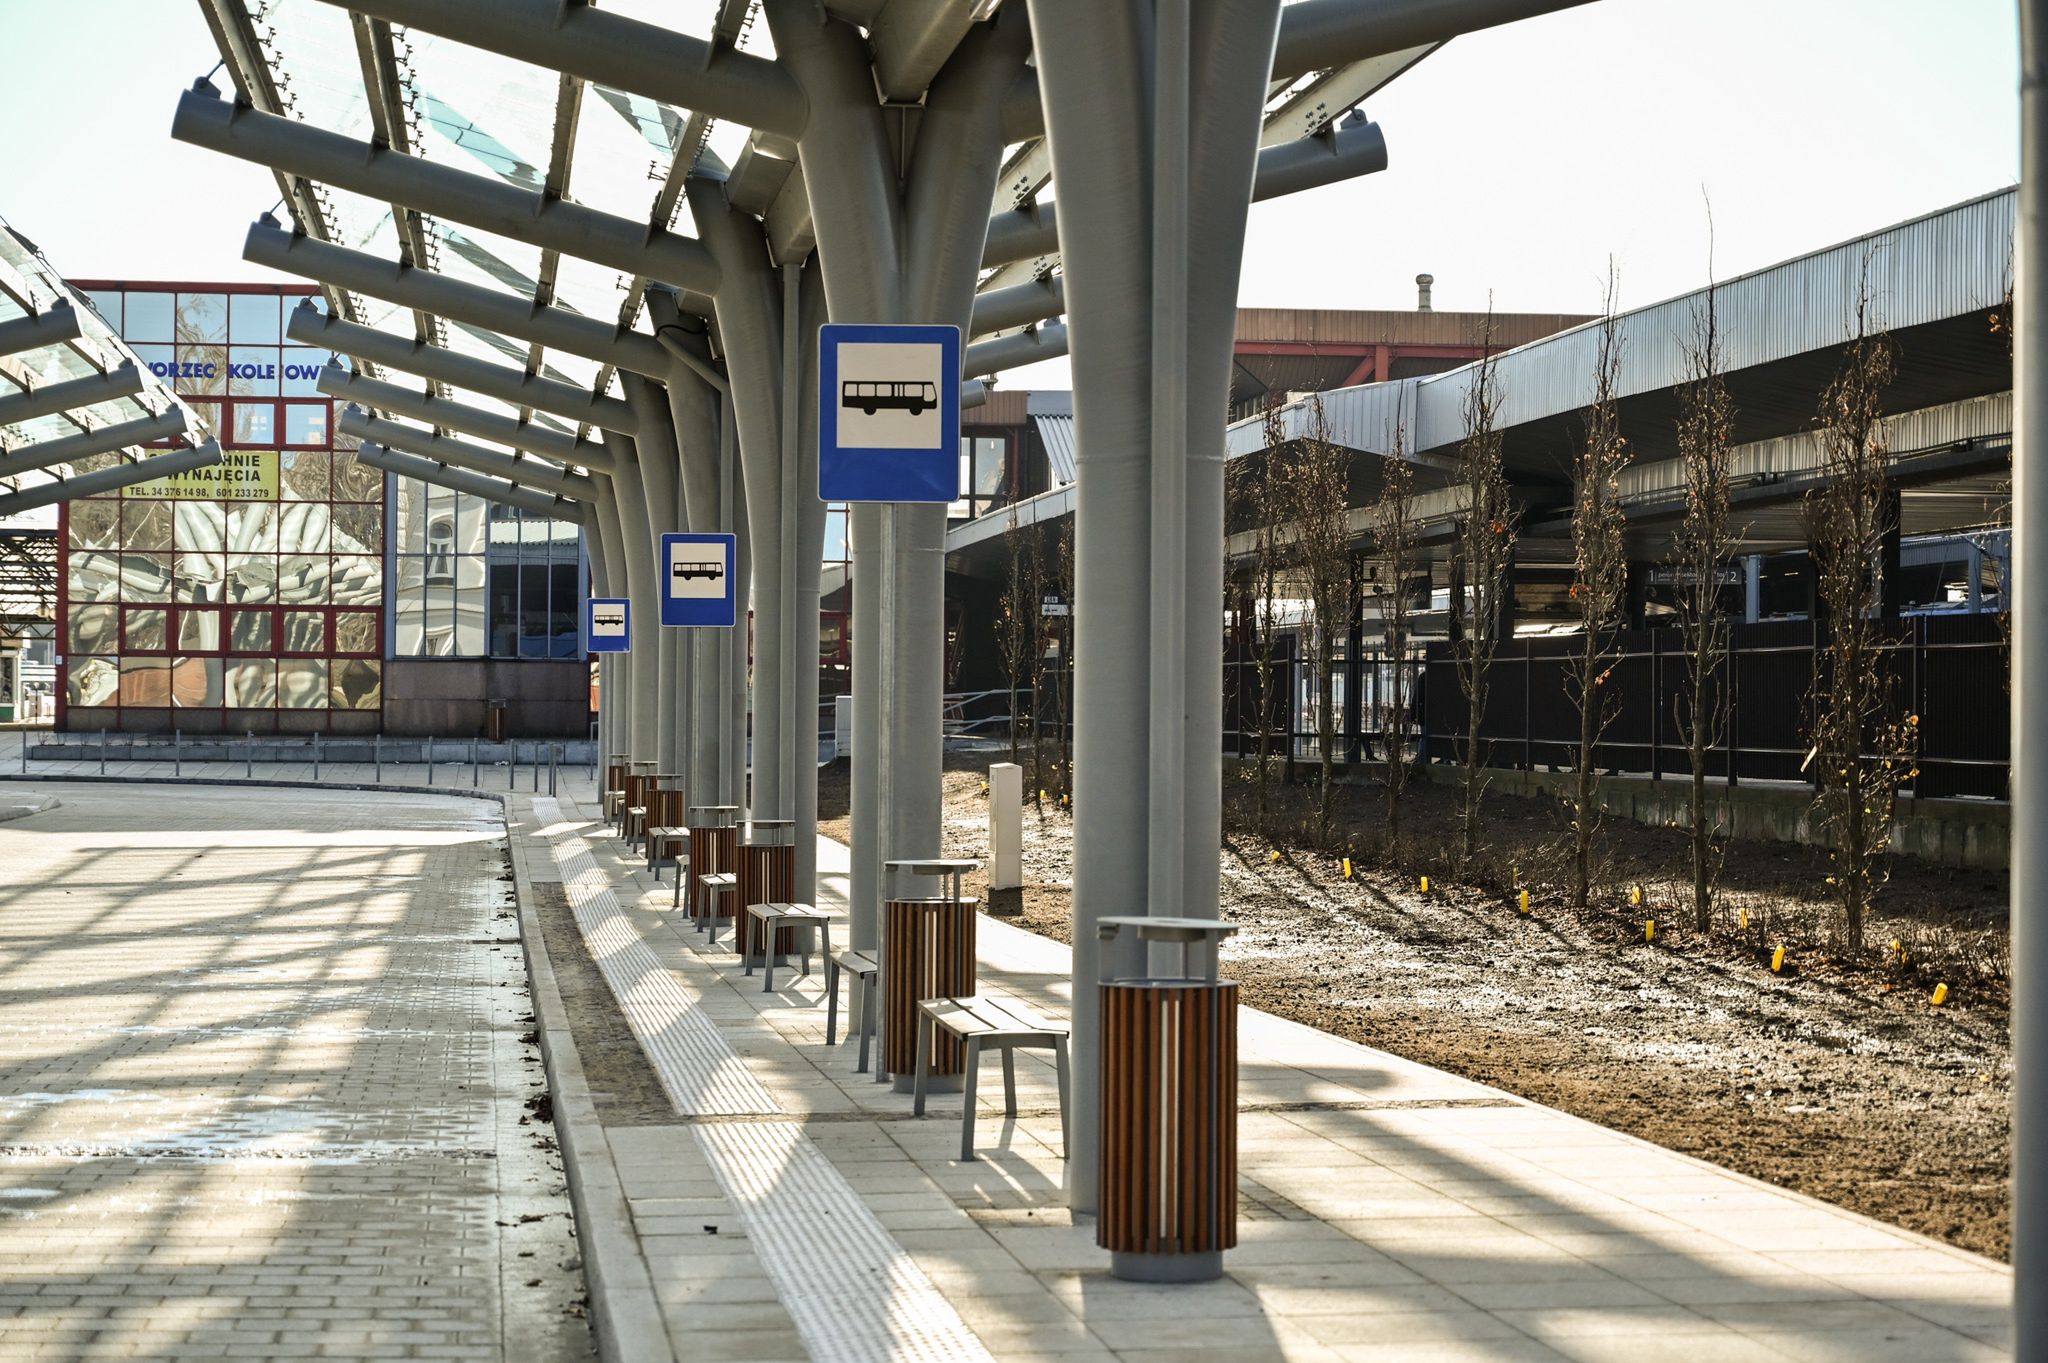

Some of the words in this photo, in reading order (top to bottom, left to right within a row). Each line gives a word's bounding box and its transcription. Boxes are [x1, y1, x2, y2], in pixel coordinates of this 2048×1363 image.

[148, 362, 215, 379] ORZEC
[129, 487, 149, 496] TEL.
[152, 487, 163, 496] 34
[164, 487, 181, 496] 376
[184, 487, 194, 496] 14
[234, 488, 251, 497] 233
[253, 489, 269, 498] 279
[1730, 571, 1737, 582] 2
